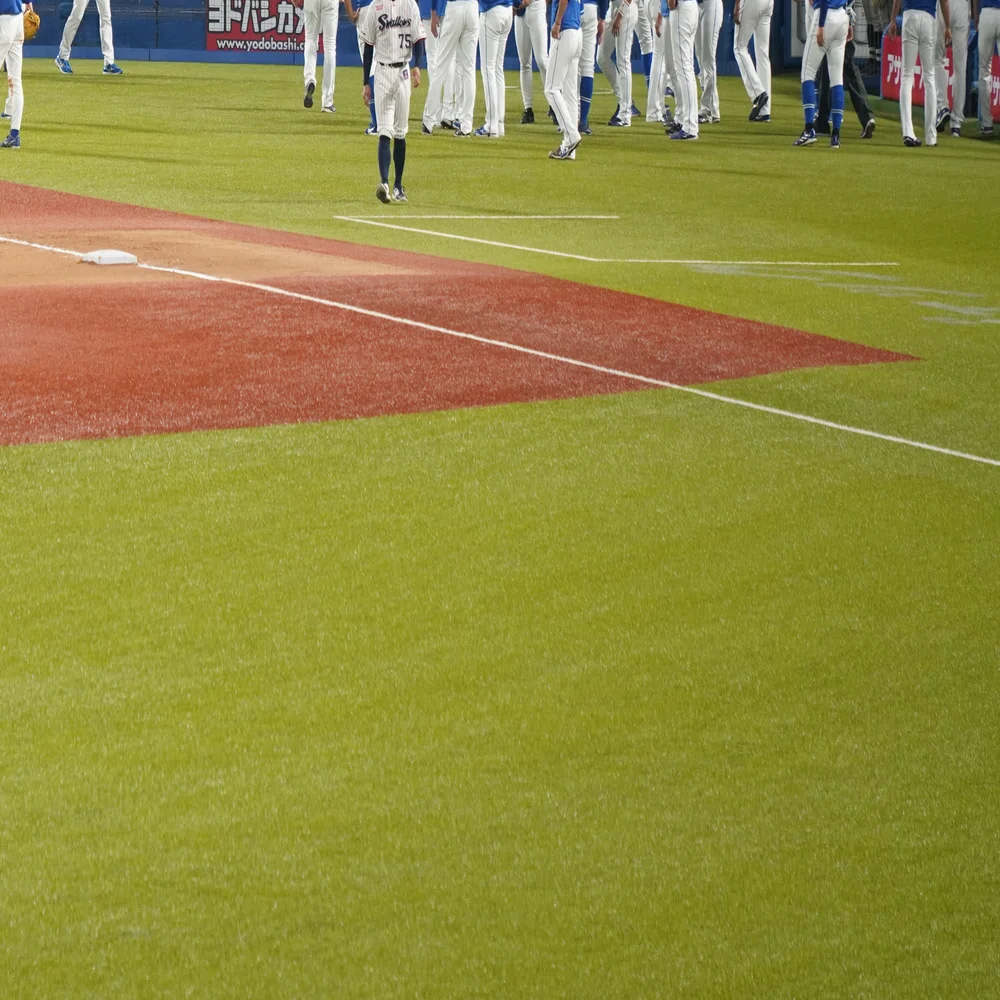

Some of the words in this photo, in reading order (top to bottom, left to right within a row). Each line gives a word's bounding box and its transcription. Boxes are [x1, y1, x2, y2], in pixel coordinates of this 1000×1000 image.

[378, 13, 412, 31] Swallows
[216, 36, 306, 52] www.yodobashi.c
[398, 33, 411, 49] 75
